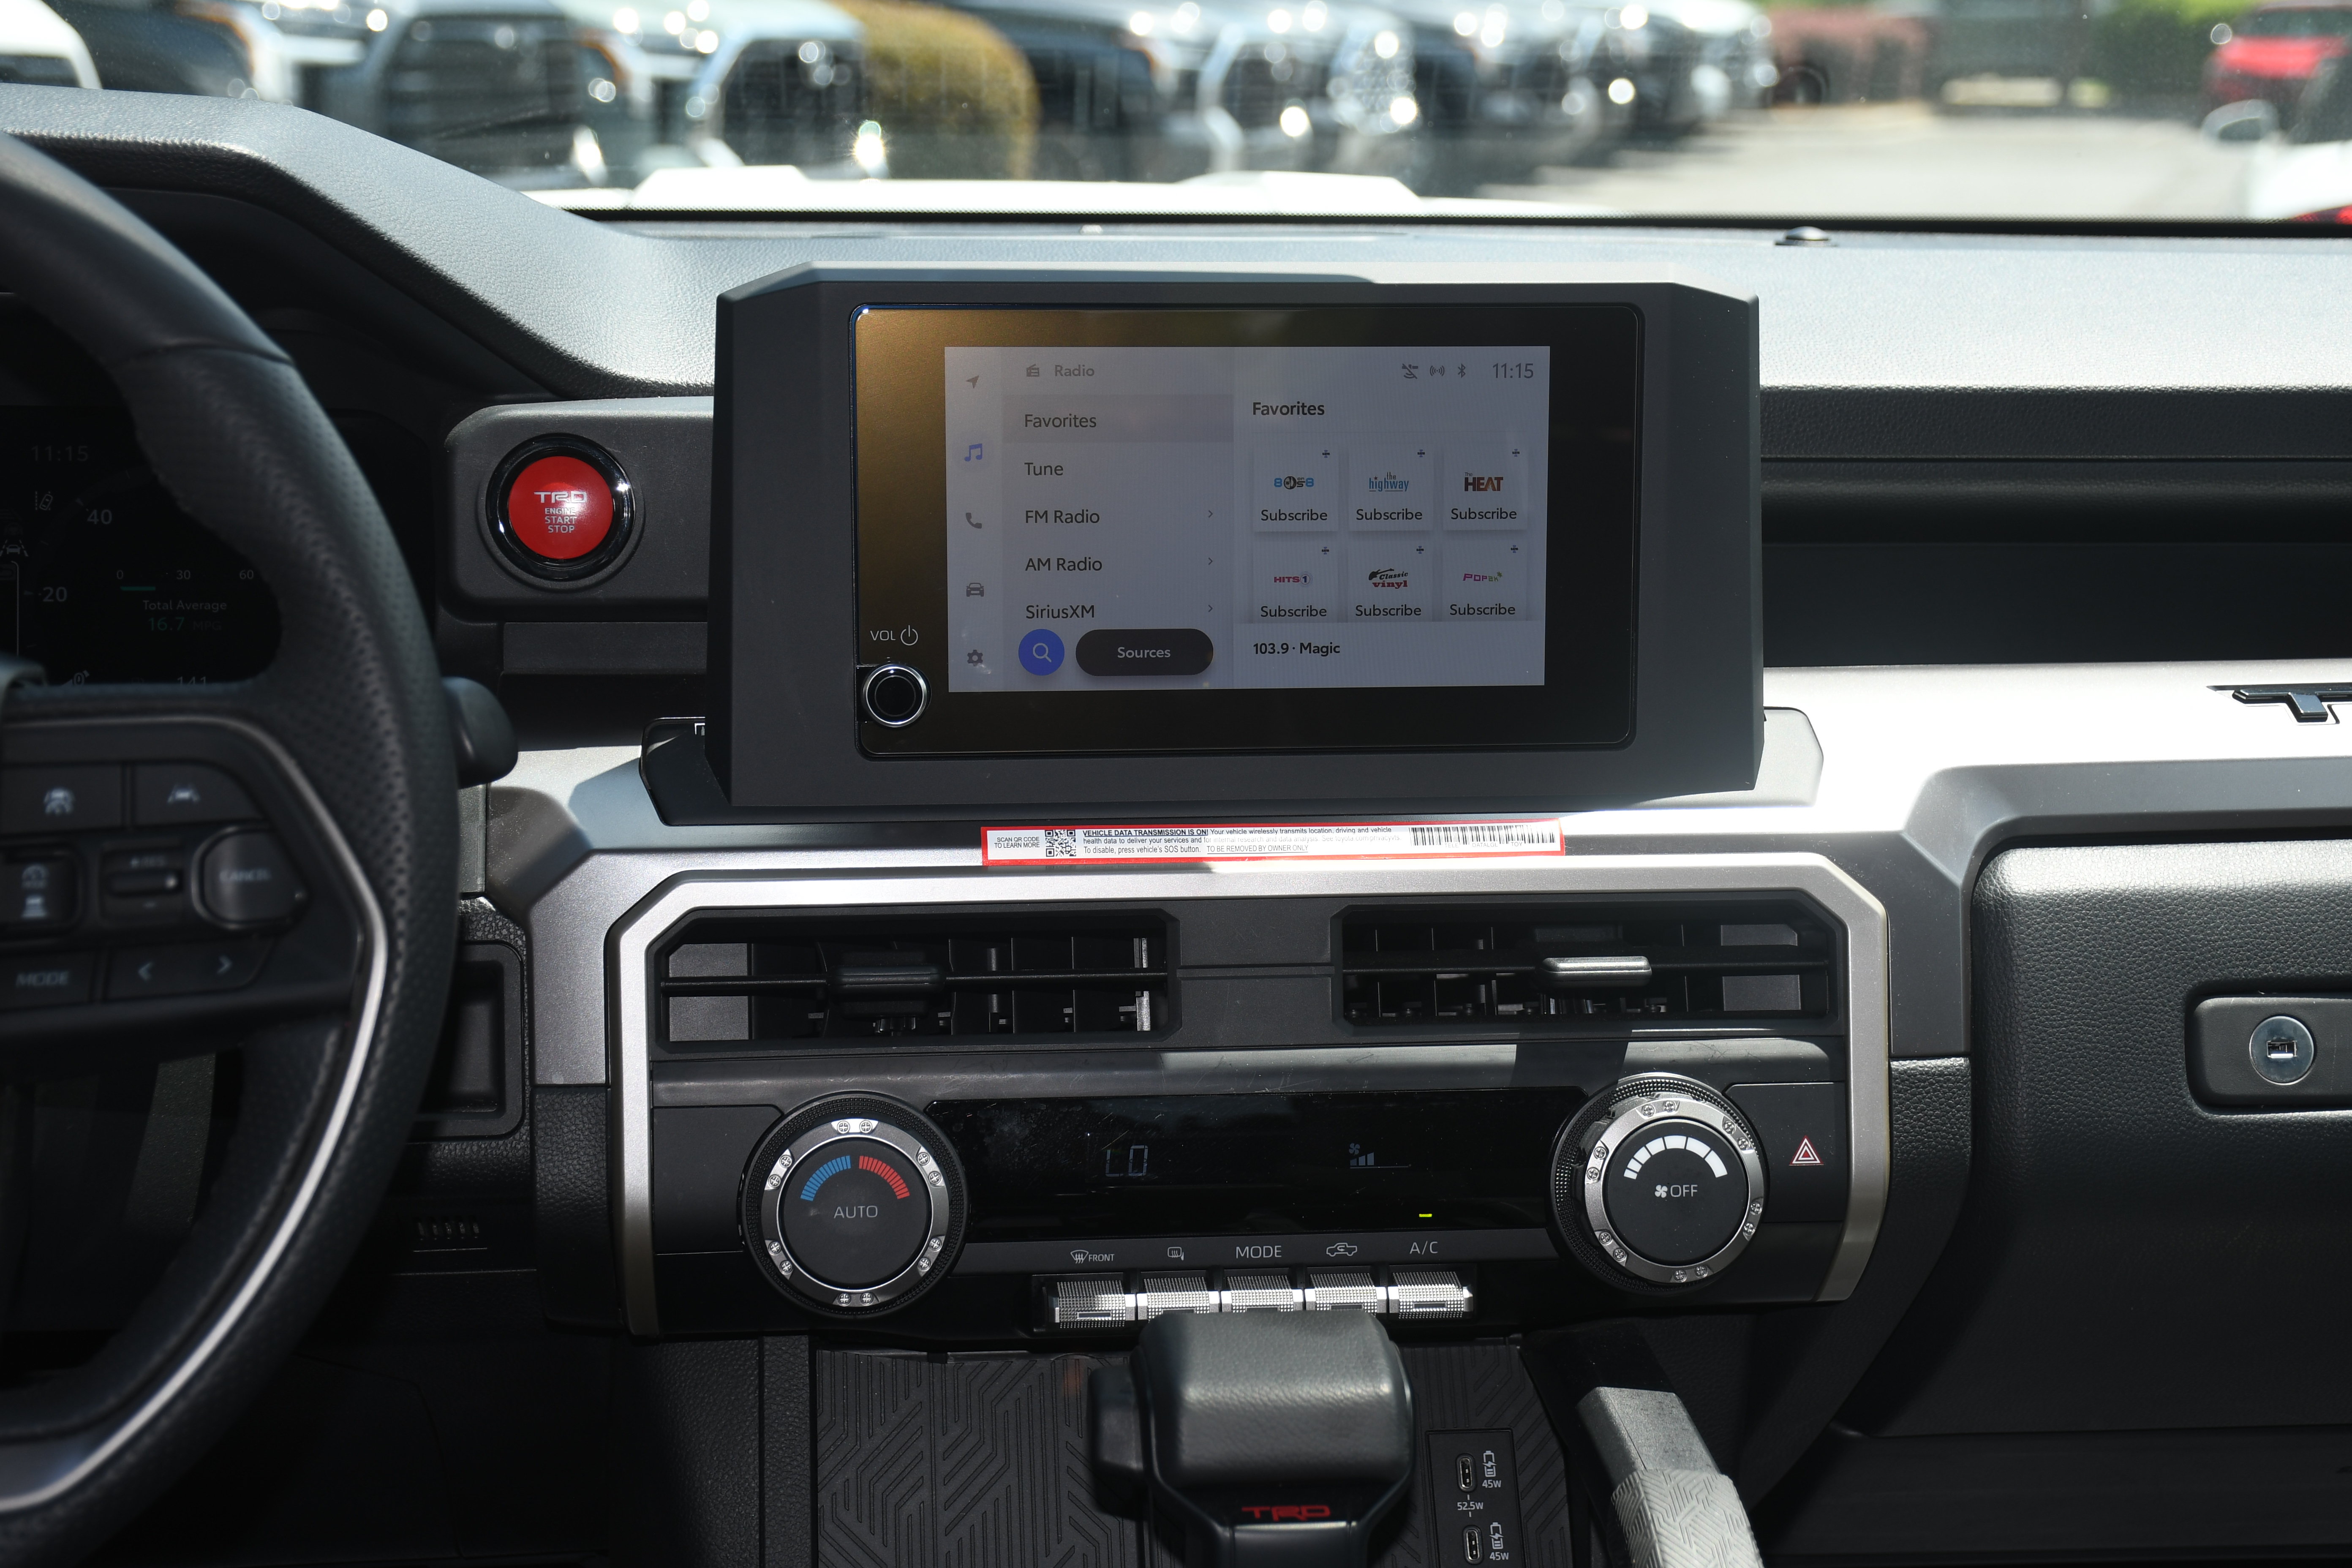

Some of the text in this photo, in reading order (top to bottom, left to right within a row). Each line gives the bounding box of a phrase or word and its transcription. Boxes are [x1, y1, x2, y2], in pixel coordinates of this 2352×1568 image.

[1054, 365, 1094, 377] Radio
[1492, 363, 1534, 378] 11:15
[1252, 402, 1325, 416] Favorites
[1024, 414, 1097, 428] Favorites
[31, 446, 89, 462] 11:15
[1024, 463, 1064, 476] Tune
[1387, 472, 1396, 480] the
[1369, 478, 1409, 492] highway
[1464, 477, 1504, 491] HEAT
[534, 491, 587, 503] TRD
[87, 510, 113, 525] 40
[544, 516, 577, 524] START
[1025, 510, 1100, 524] FM Radio
[1261, 509, 1328, 521] Subscribe
[1356, 508, 1423, 520] Subscribe
[1451, 508, 1517, 520] Subscribe
[1025, 557, 1102, 571] AM Radio
[117, 570, 124, 579] 0
[176, 570, 191, 580] 30
[239, 570, 254, 580] 60
[1379, 571, 1408, 580] Classic
[1372, 580, 1408, 589] vinyl
[43, 587, 68, 602] 20
[143, 600, 227, 612] Total Average
[1026, 604, 1095, 619] SiriusXM
[1260, 605, 1327, 617] Subscribe
[1355, 604, 1422, 616] Subscribe
[1449, 604, 1516, 615] Subscribe
[148, 617, 222, 631] 16.7 MPG
[870, 630, 896, 641] VOL
[1117, 646, 1171, 659] Sources
[1253, 642, 1340, 657] 103.9 Magic
[1093, 846, 1116, 854] disable,
[1118, 847, 1135, 855] press
[16, 971, 70, 988] MODE
[1670, 1184, 1698, 1197] OFF
[833, 1205, 878, 1219] AUTO
[1236, 1245, 1282, 1259] MODE
[1410, 1241, 1438, 1255] A/C
[1089, 1253, 1115, 1262] FRONT
[1482, 1480, 1502, 1488] 45W
[1457, 1502, 1484, 1510] 52.5W
[1241, 1505, 1331, 1521] TRD
[1489, 1552, 1509, 1560] 45W
